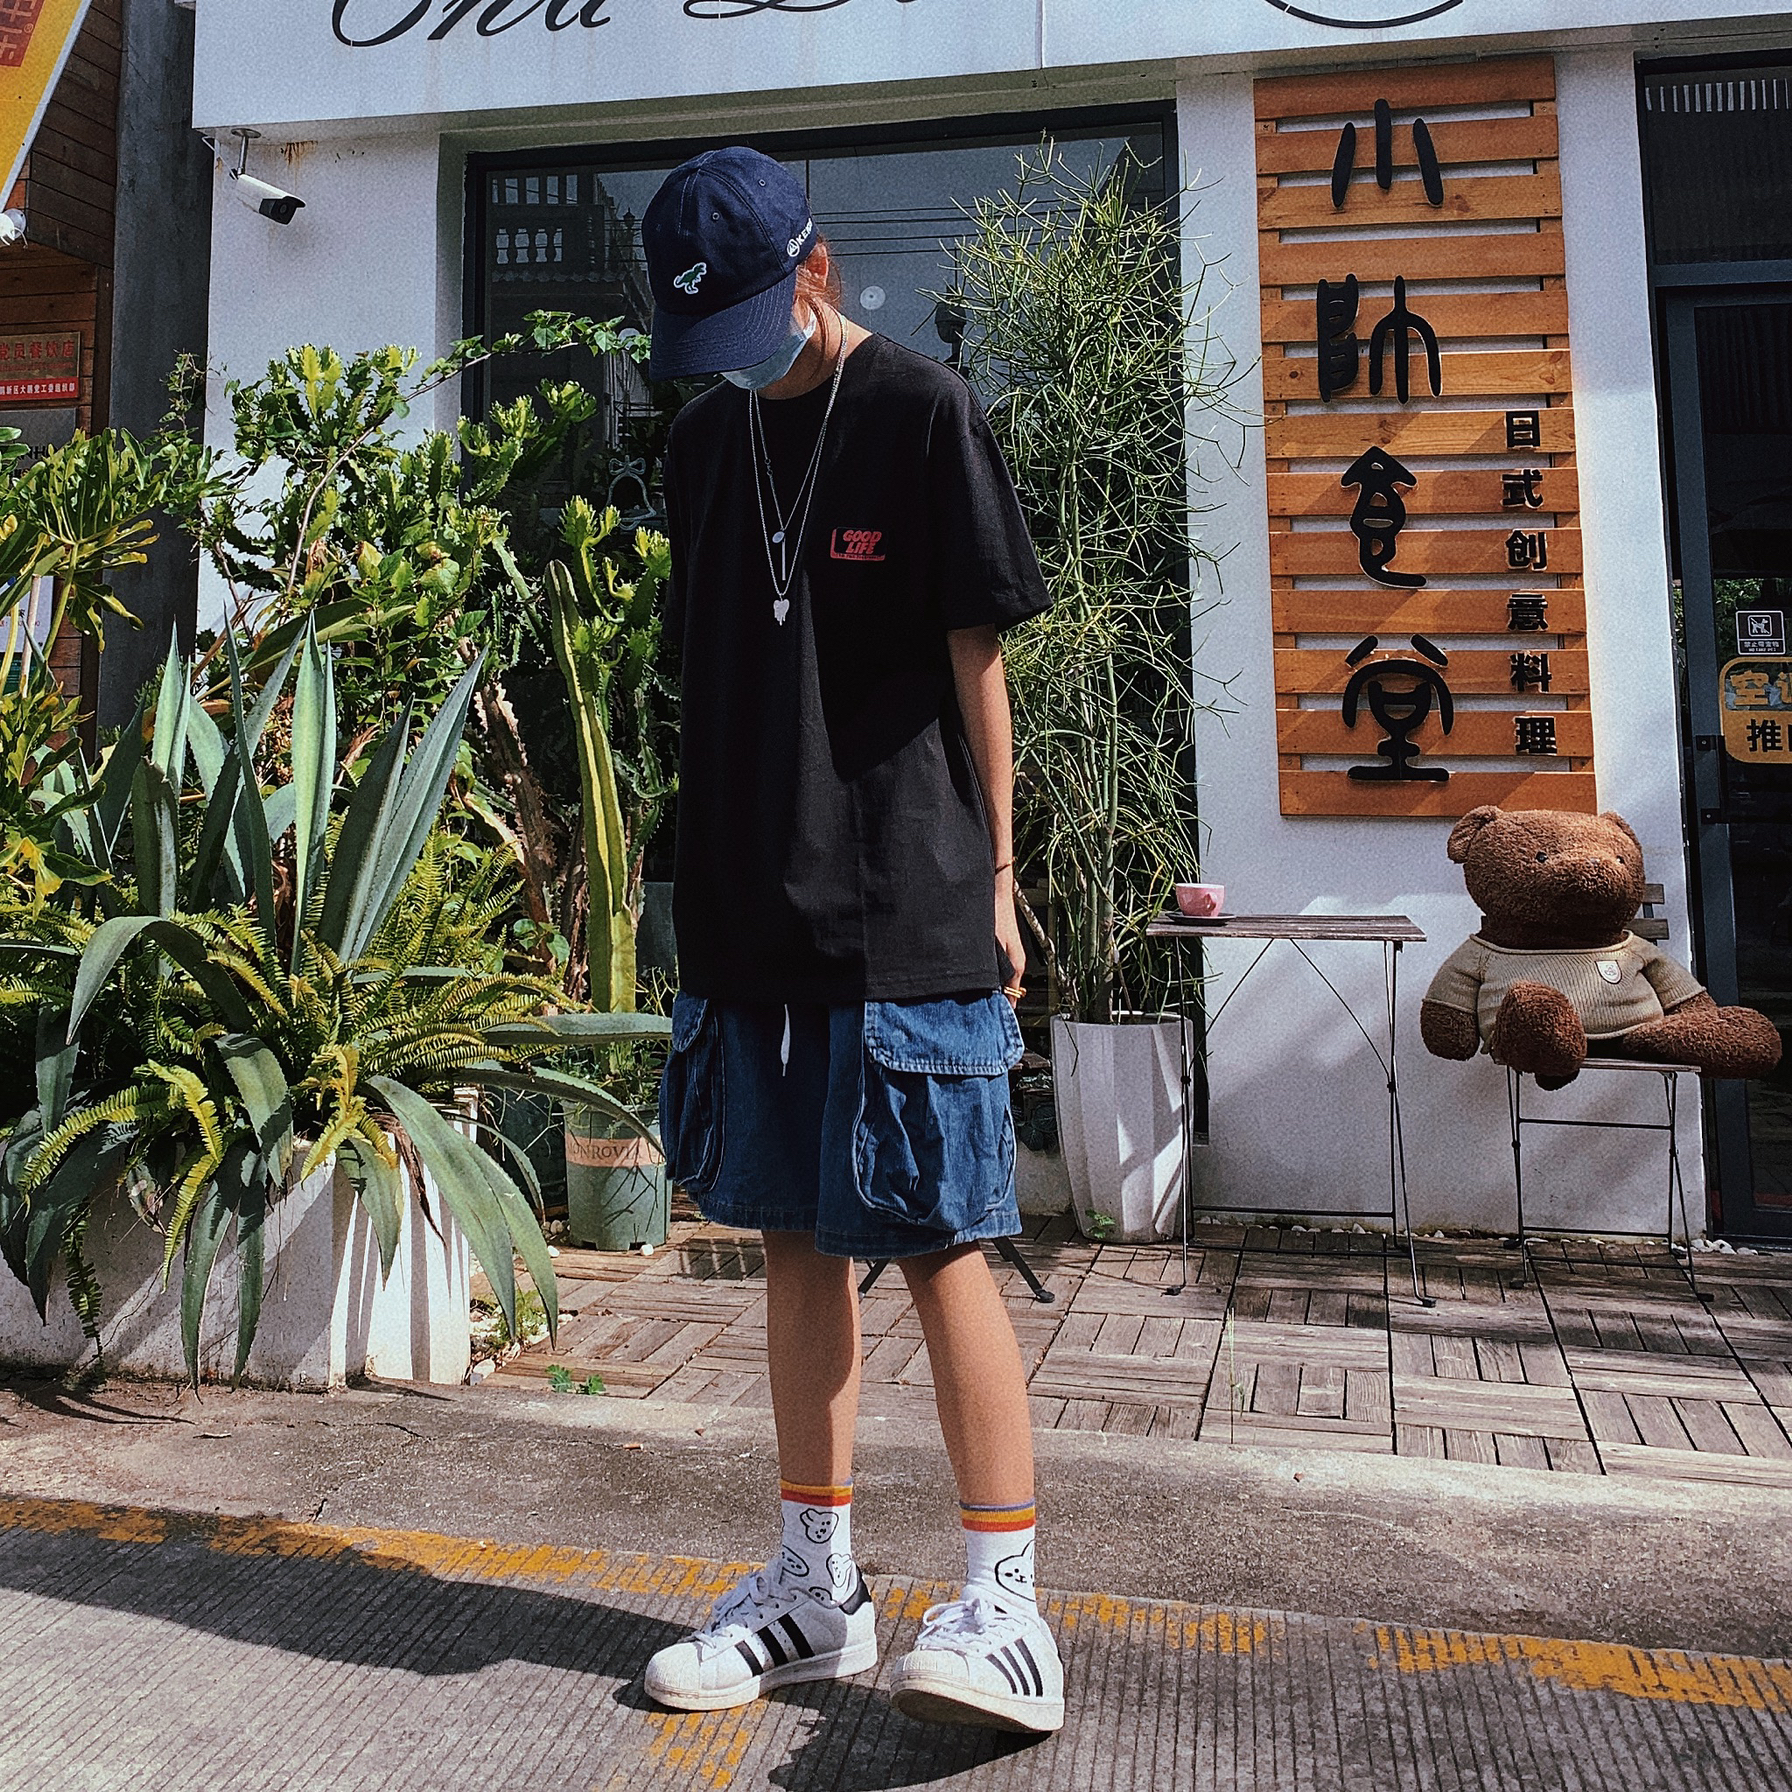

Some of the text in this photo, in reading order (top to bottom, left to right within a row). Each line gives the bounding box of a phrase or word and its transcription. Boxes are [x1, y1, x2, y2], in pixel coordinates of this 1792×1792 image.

[843, 529, 882, 542] GOOD
[846, 541, 876, 554] LIFE
[1500, 410, 1558, 755] 日式创意料理
[1746, 718, 1792, 753] 推
